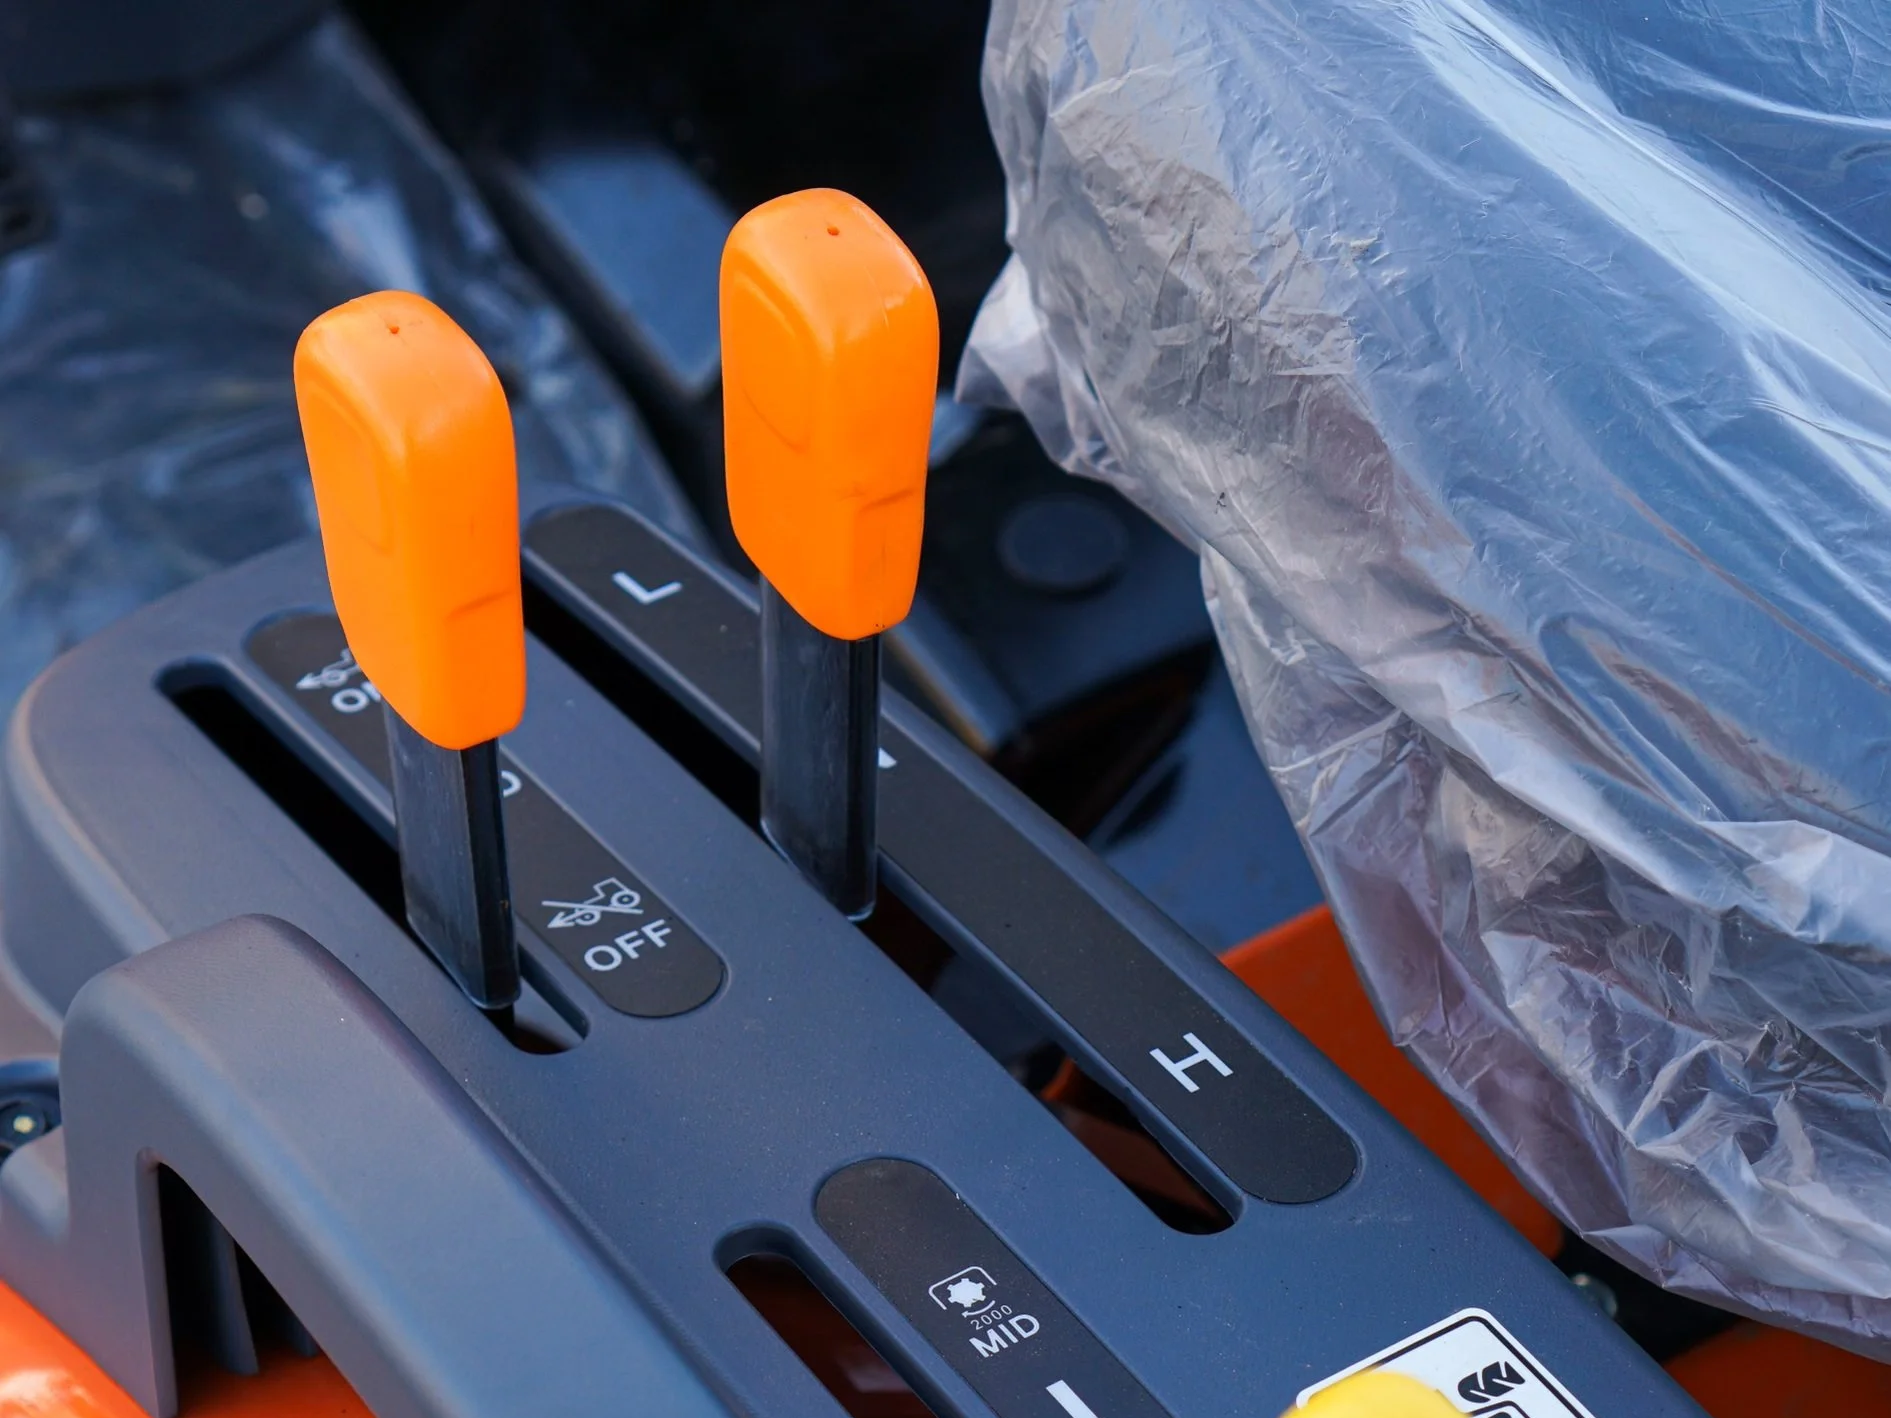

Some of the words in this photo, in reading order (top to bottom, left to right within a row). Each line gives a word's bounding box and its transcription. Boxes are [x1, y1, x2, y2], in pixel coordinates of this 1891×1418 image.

[612, 572, 682, 605] L
[584, 919, 673, 971] OFF
[1149, 1032, 1234, 1093] H
[969, 1313, 1040, 1358] MID
[970, 1304, 1013, 1330] 2000
